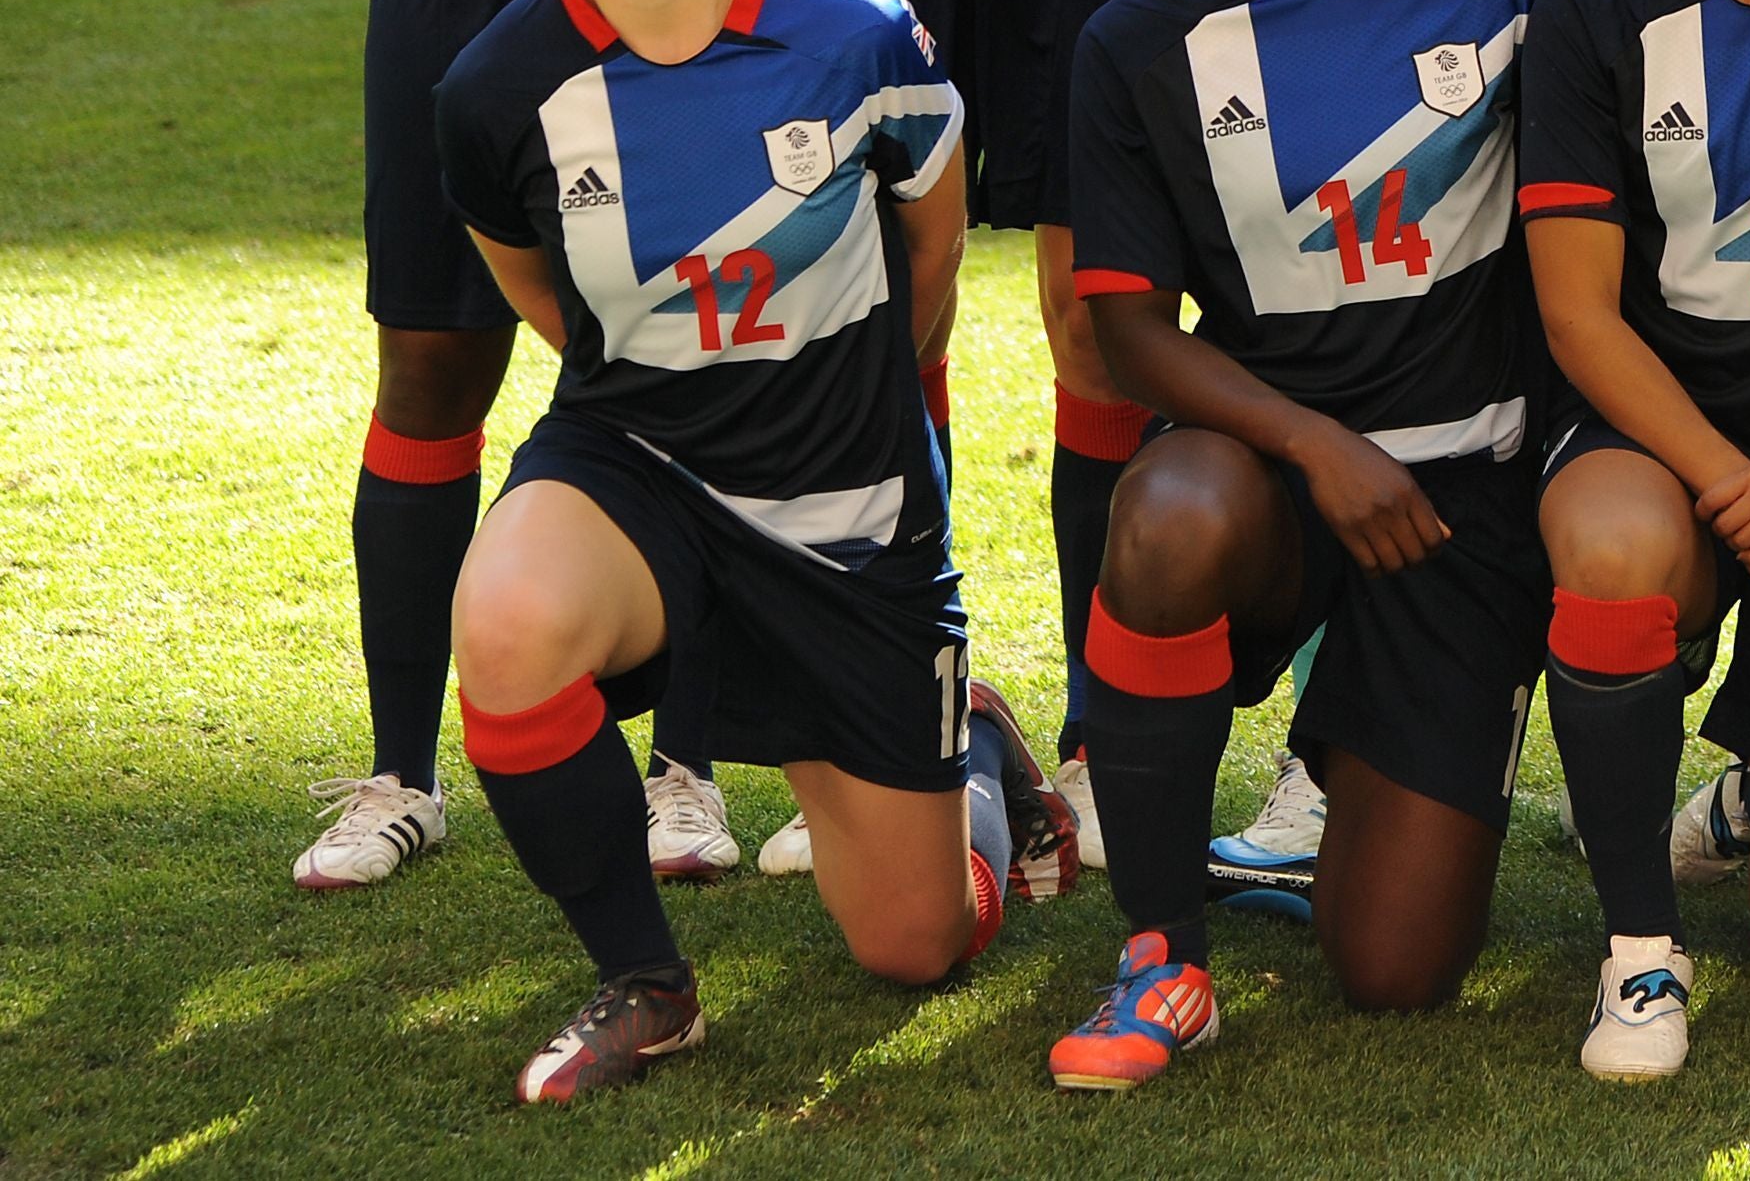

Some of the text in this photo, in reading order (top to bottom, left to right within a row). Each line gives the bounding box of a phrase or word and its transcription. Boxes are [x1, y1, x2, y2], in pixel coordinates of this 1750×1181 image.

[1434, 72, 1467, 83] TEAM GB
[1205, 116, 1266, 139] adidas
[1644, 125, 1705, 142] adidas
[784, 150, 817, 162] TEAM GB
[561, 191, 620, 209] adidas
[1316, 168, 1432, 284] 14
[675, 248, 785, 351] 12
